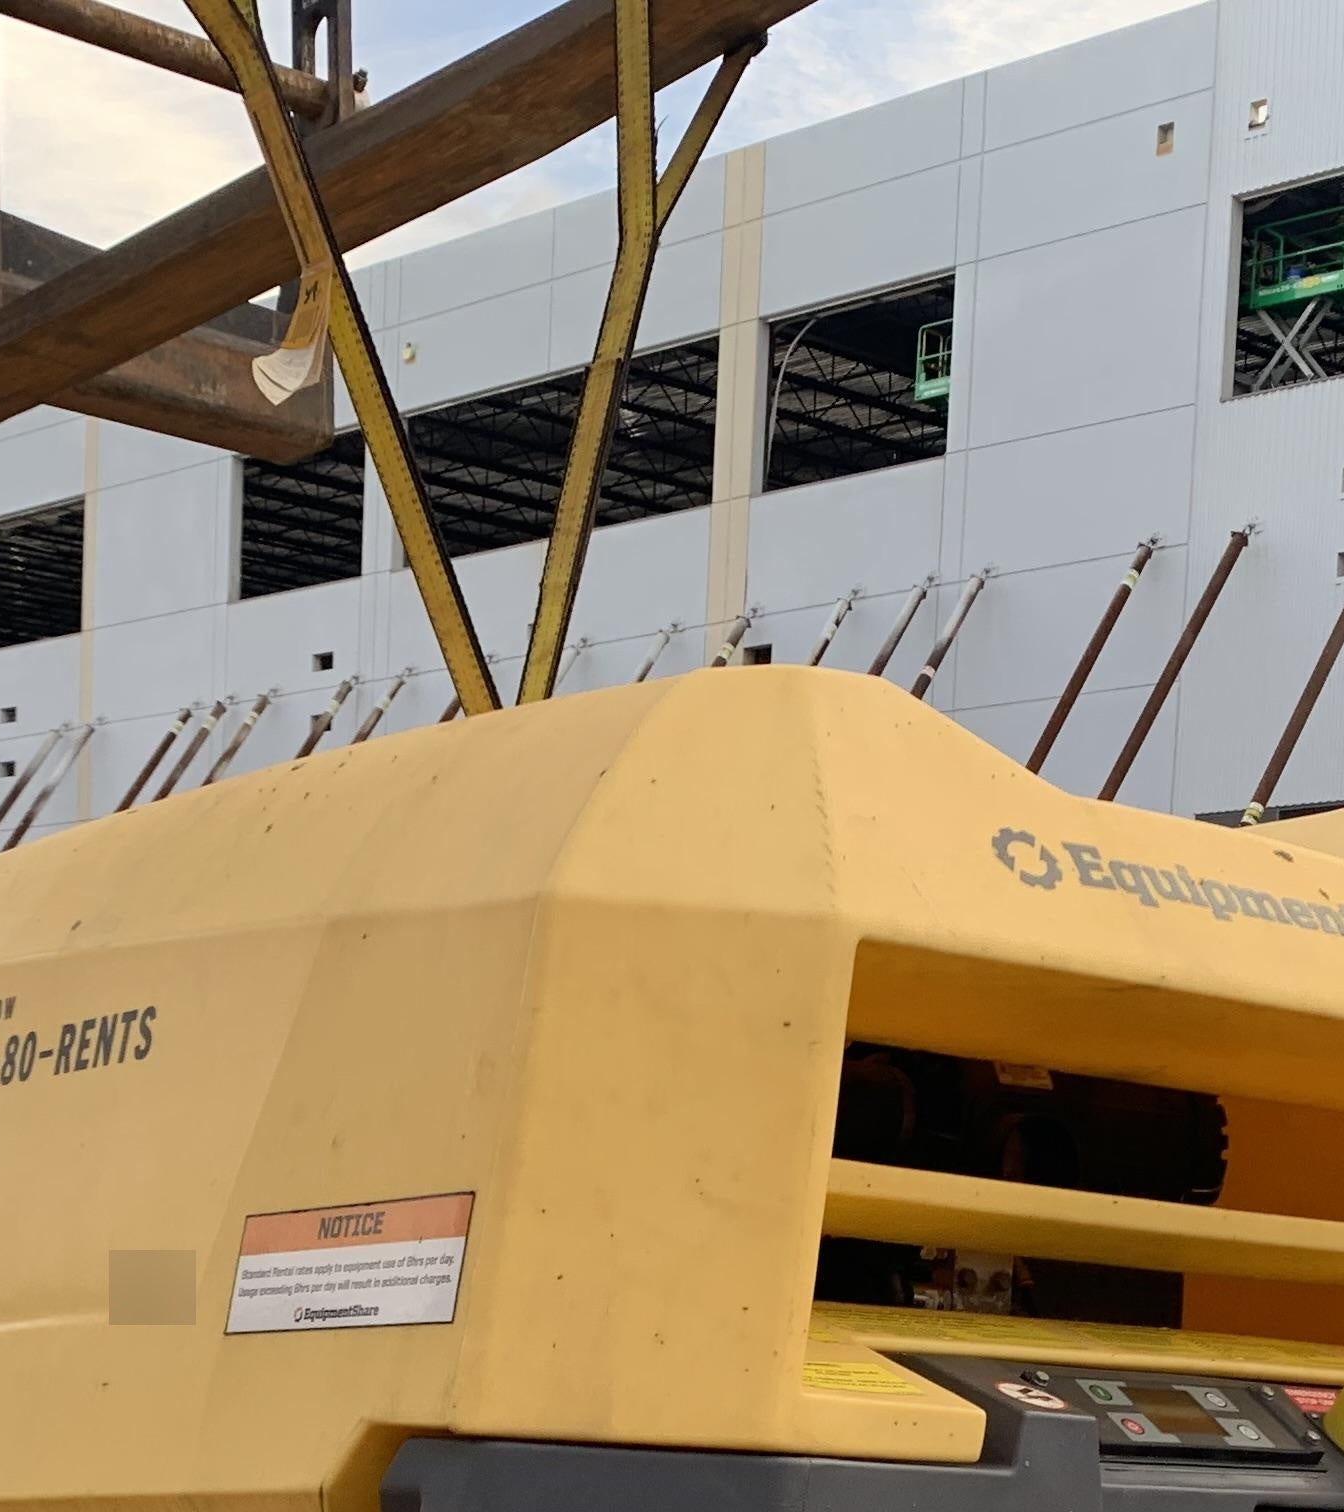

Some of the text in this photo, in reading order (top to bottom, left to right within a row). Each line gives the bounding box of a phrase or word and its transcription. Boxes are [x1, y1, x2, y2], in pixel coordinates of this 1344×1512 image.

[317, 1211, 385, 1240] NOTICE
[272, 1266, 294, 1277] Rental
[295, 1266, 313, 1275] rates
[314, 1264, 333, 1275] apply
[334, 1264, 342, 1272] to
[343, 1260, 381, 1273] equipment
[382, 1260, 396, 1269] use
[397, 1257, 406, 1267] of
[425, 1257, 438, 1268] per
[311, 1283, 323, 1293] per
[324, 1282, 336, 1293] day
[337, 1279, 350, 1290] will
[351, 1279, 373, 1289] result
[373, 1278, 380, 1287] in
[381, 1276, 419, 1287] additional
[303, 1305, 379, 1322] EquipmentShare
